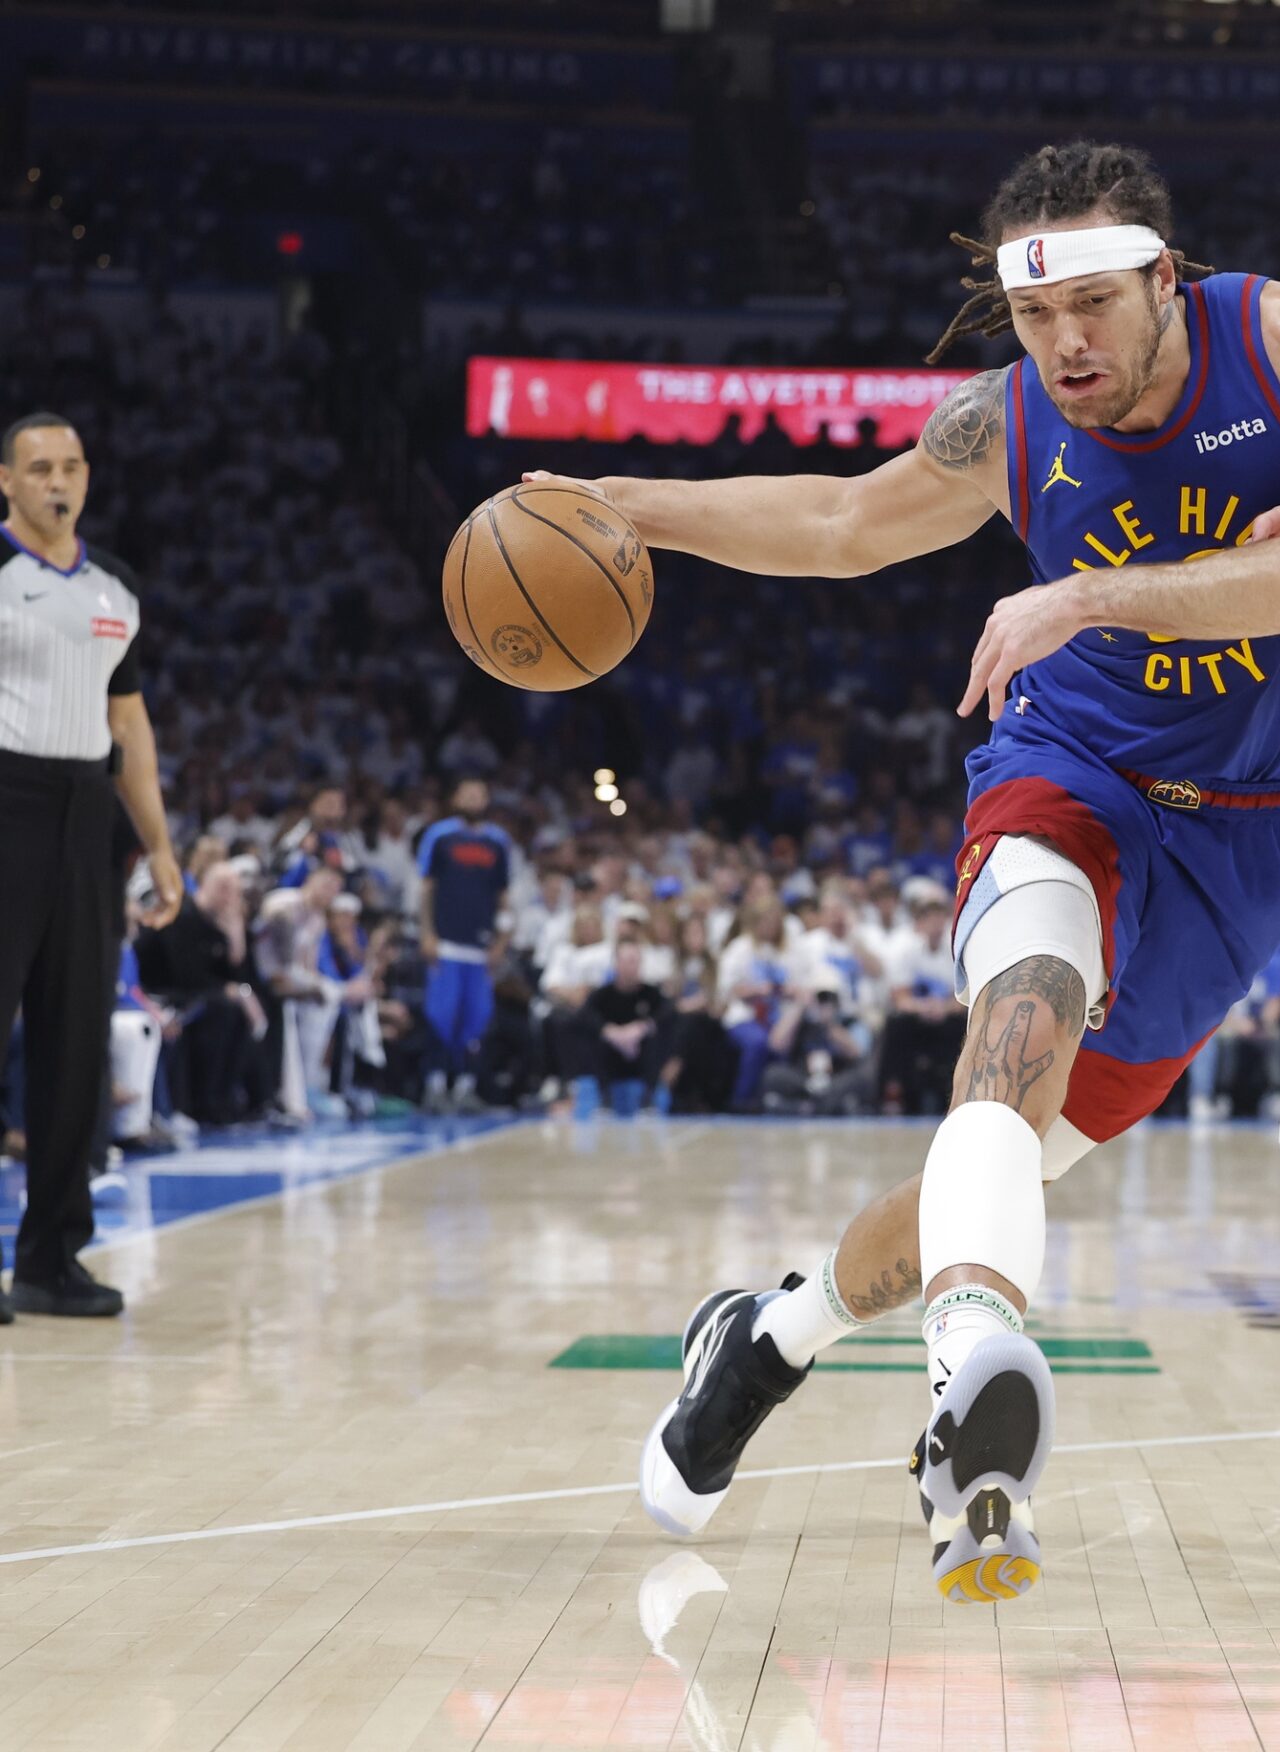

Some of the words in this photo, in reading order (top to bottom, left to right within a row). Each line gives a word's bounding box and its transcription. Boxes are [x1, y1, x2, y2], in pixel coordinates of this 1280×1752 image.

[638, 370, 714, 404] THE
[1194, 417, 1267, 455] ibotta
[1144, 638, 1266, 695] CITY
